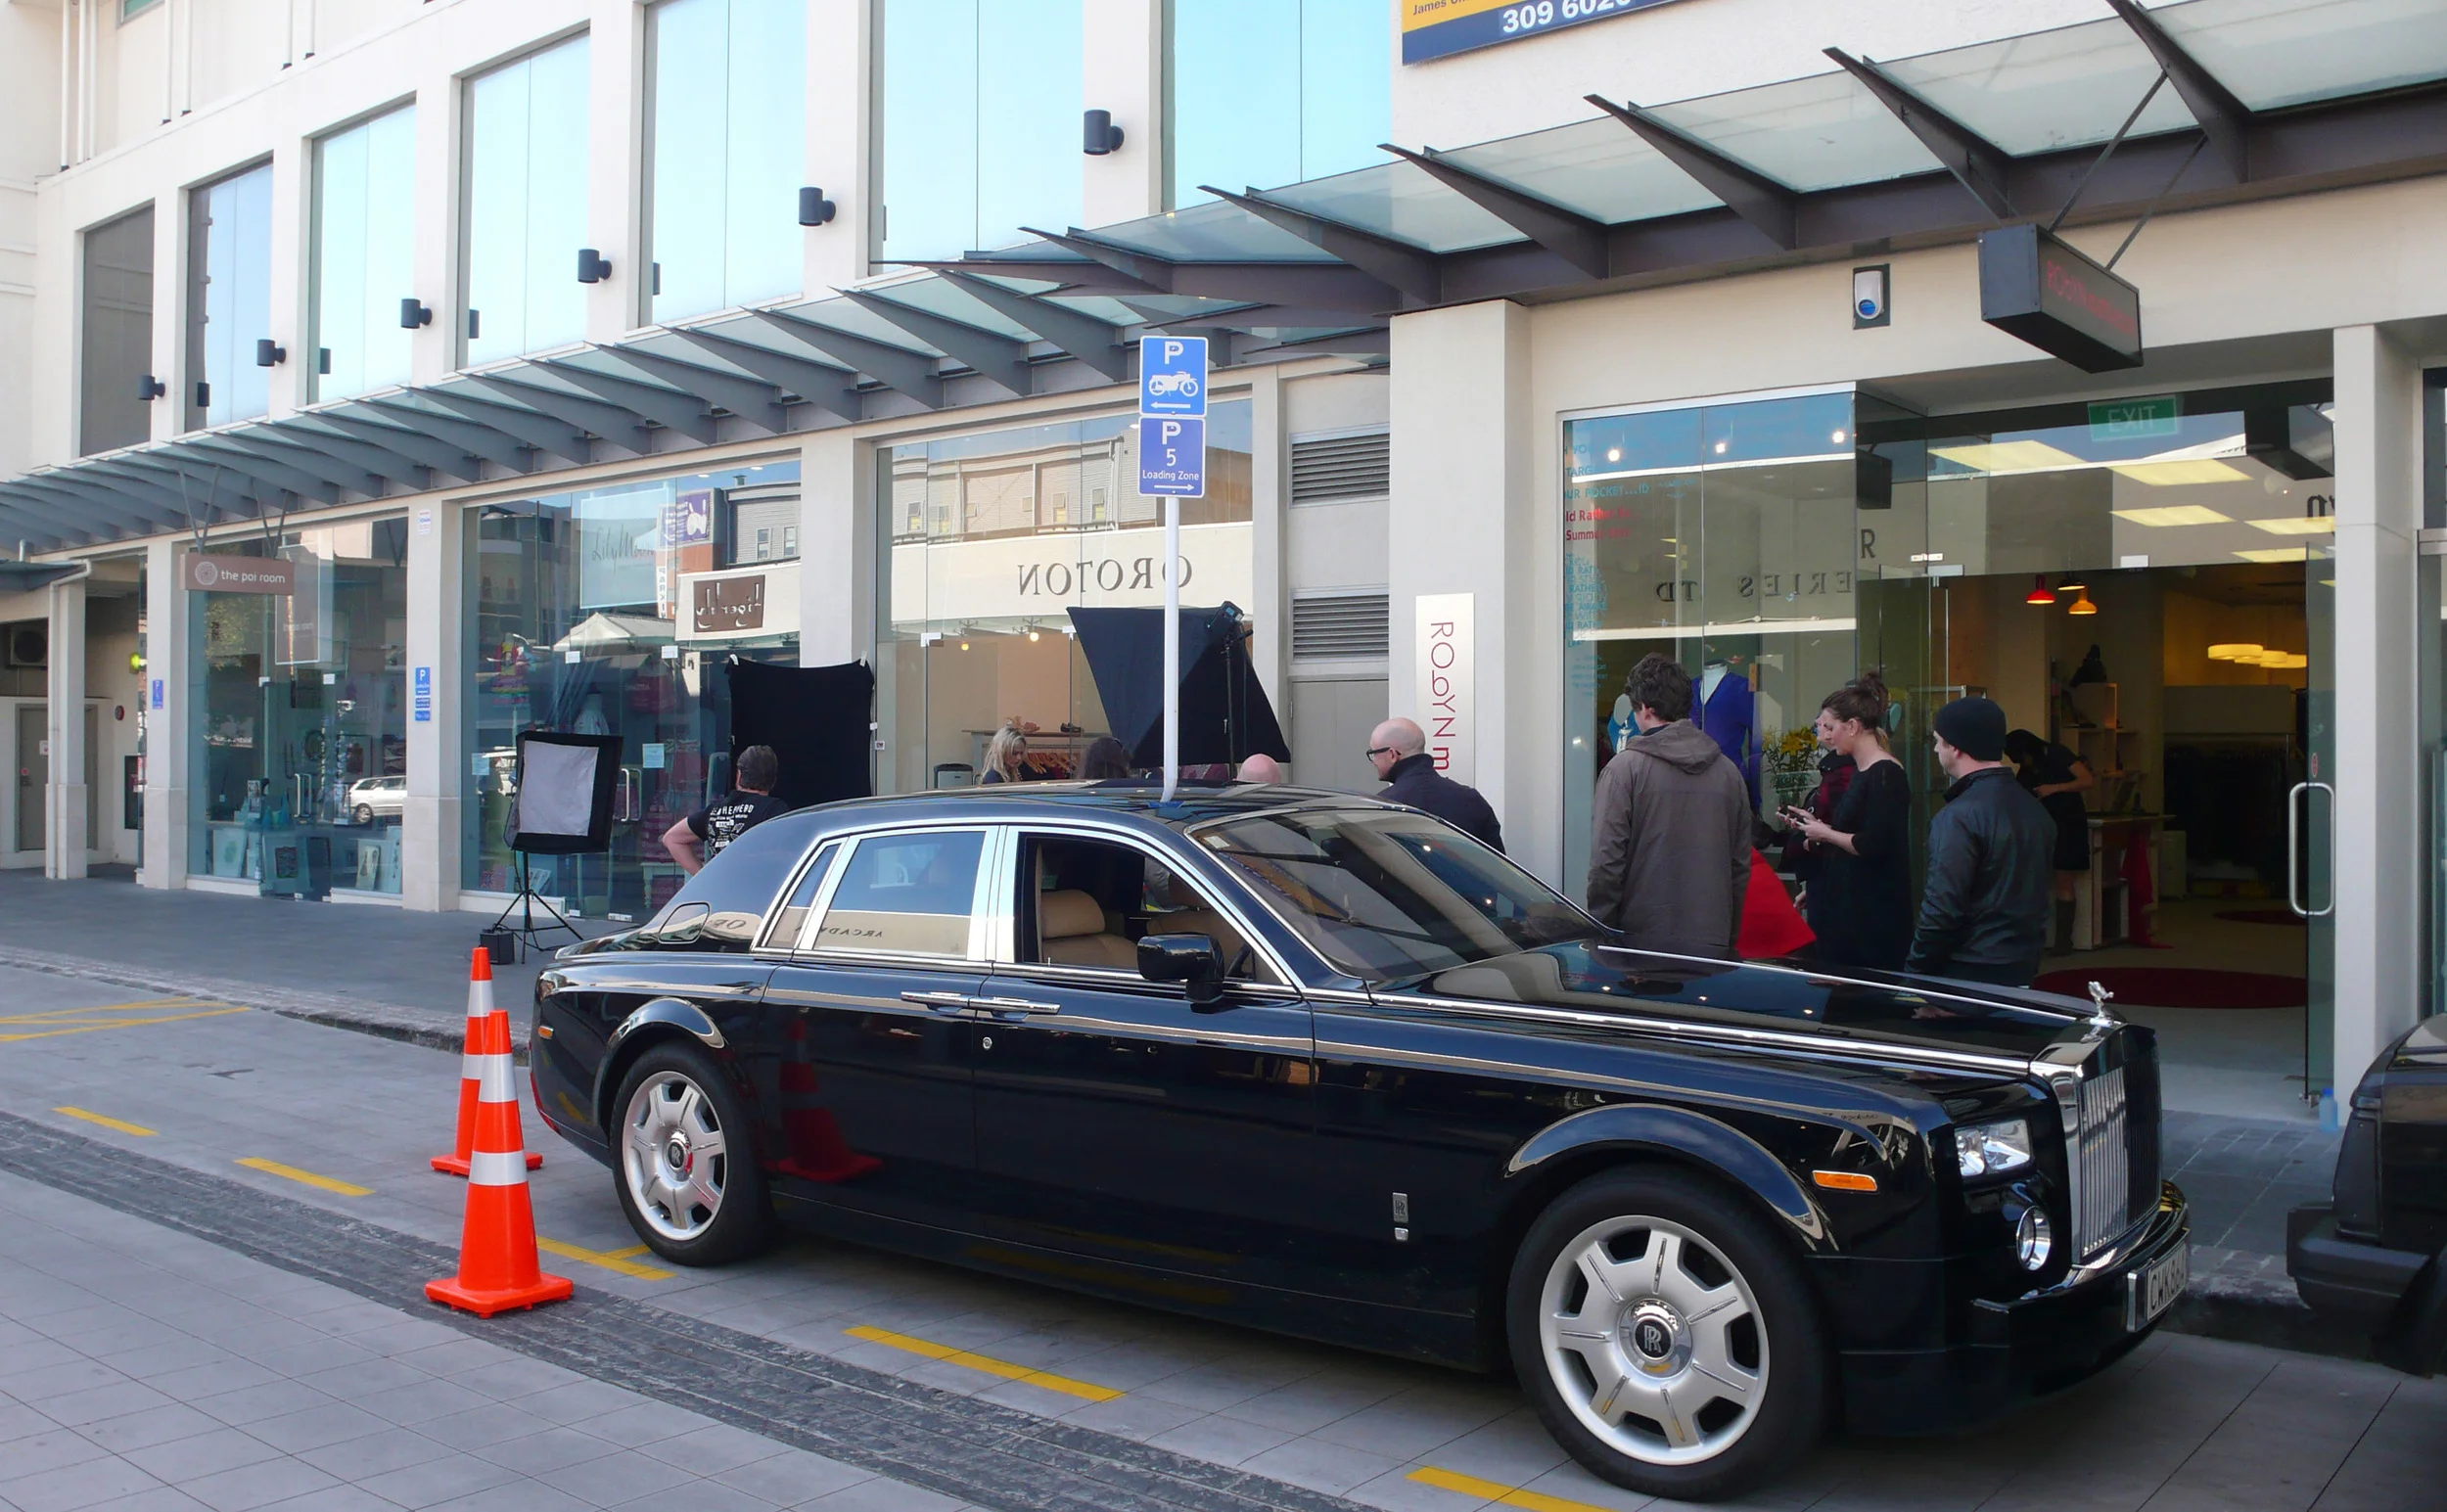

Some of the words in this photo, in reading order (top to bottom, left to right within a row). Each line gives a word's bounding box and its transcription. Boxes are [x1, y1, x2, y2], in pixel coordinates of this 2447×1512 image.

[1413, 0, 1447, 15] James
[1502, 1, 1554, 32] 309
[1165, 341, 1184, 365] P
[2107, 405, 2156, 433] EXIT
[1162, 421, 1181, 445] P
[1166, 448, 1177, 467] 5
[1142, 469, 1176, 481] Loading
[1178, 470, 1200, 481] Zone
[221, 570, 239, 581] the
[242, 572, 256, 582] poi
[259, 574, 285, 583] room
[419, 668, 427, 681] P
